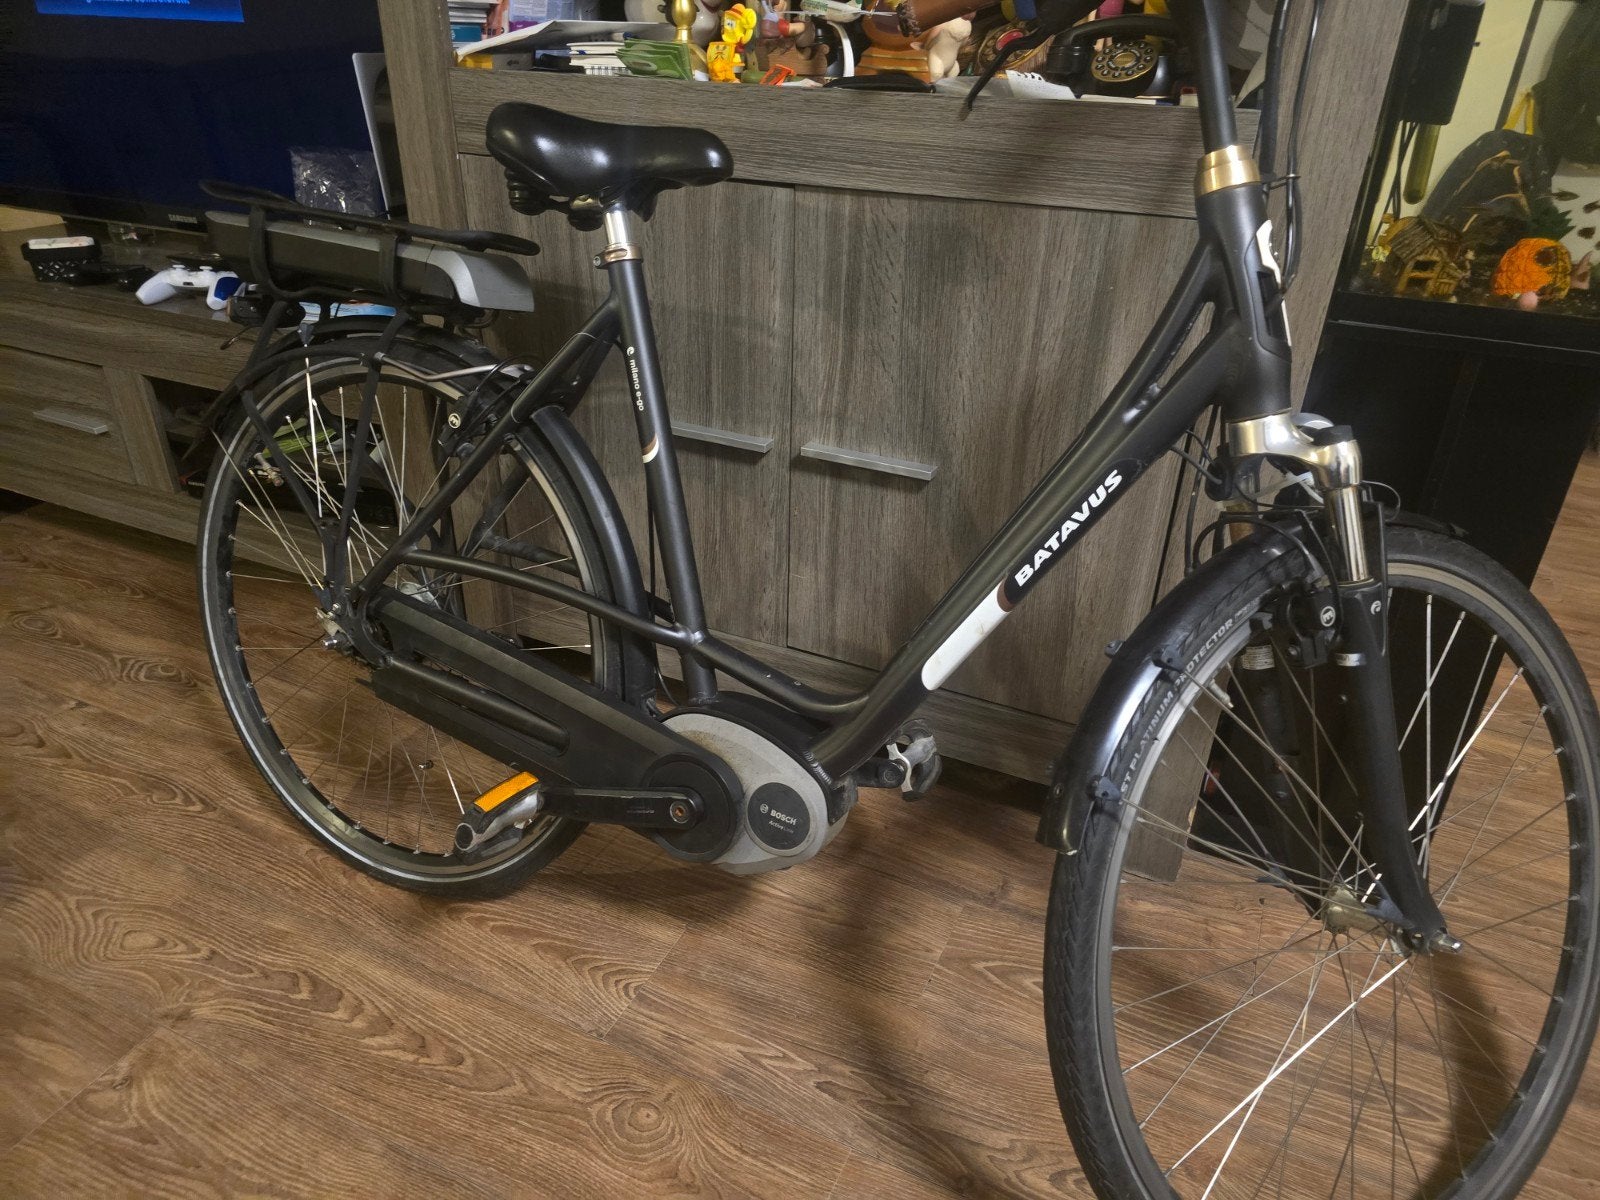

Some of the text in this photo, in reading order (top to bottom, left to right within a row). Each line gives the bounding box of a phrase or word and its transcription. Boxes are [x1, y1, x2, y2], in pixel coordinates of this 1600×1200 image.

[630, 359, 644, 411] milano e-go
[1014, 469, 1123, 587] BATAVUS
[1129, 690, 1174, 770] PLATINUM
[771, 809, 797, 825] BOSCH
